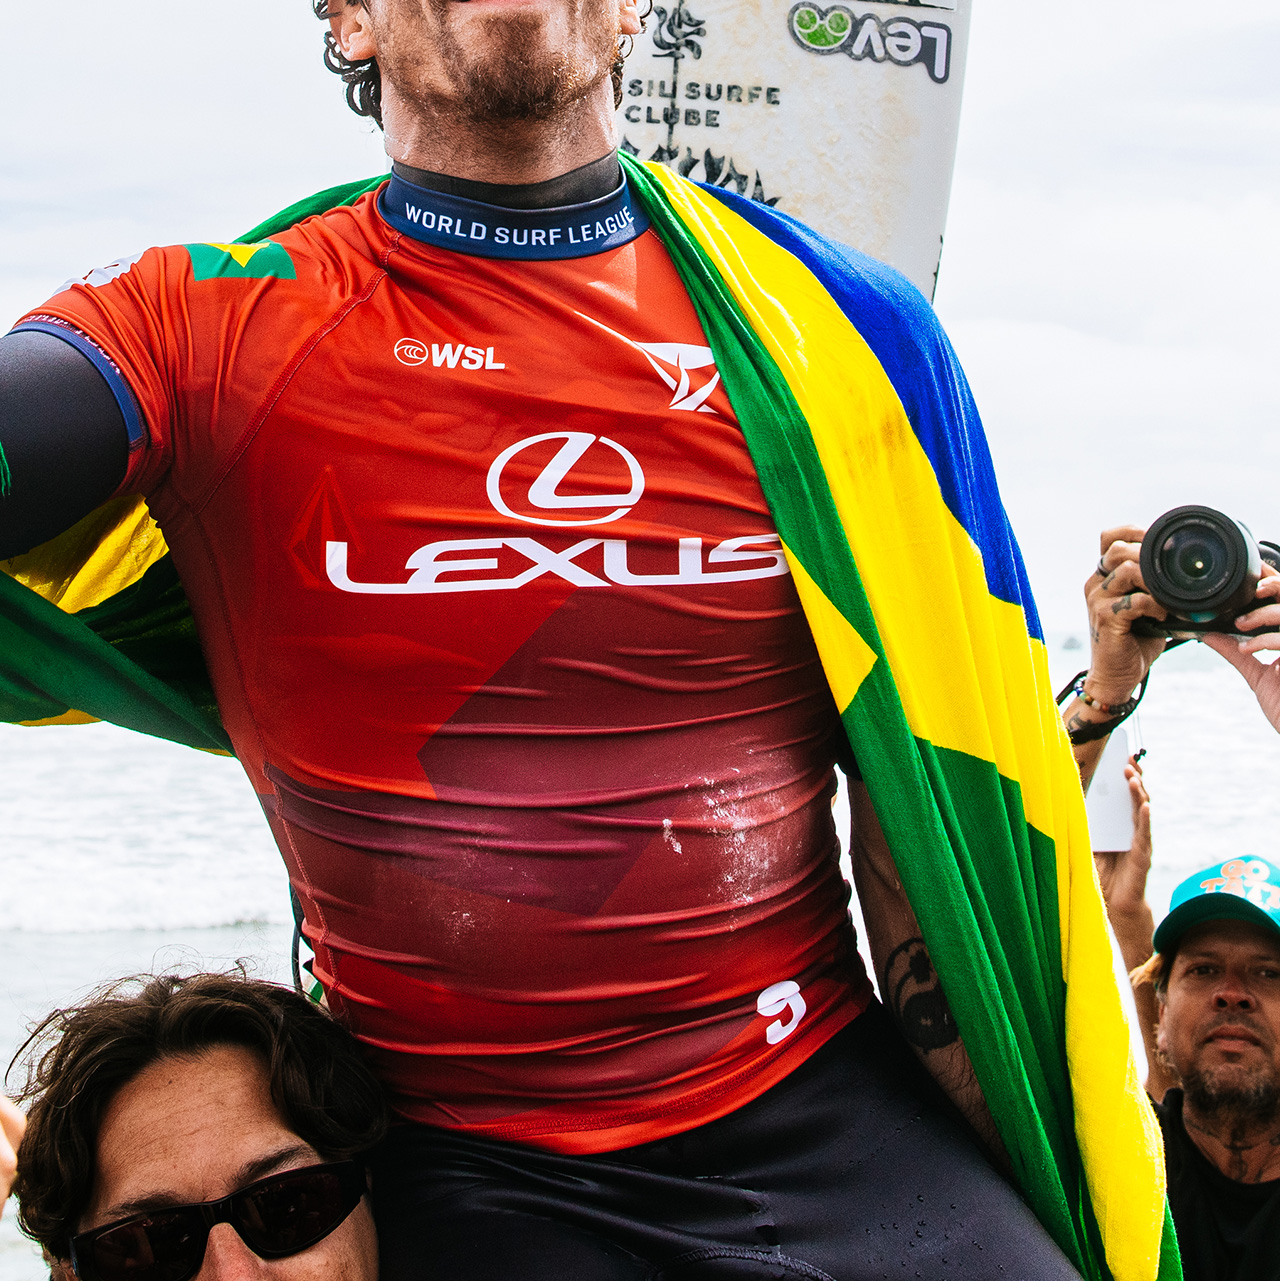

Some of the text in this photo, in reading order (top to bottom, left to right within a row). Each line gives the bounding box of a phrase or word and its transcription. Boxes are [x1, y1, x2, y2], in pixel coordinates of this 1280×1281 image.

[627, 78, 781, 106] SIL SURFE
[624, 104, 721, 128] CLUBE
[405, 202, 635, 247] WORLD SURF LEAGUE
[431, 343, 506, 370] WSL
[325, 532, 793, 594] LEXUS
[1221, 859, 1271, 882] GO
